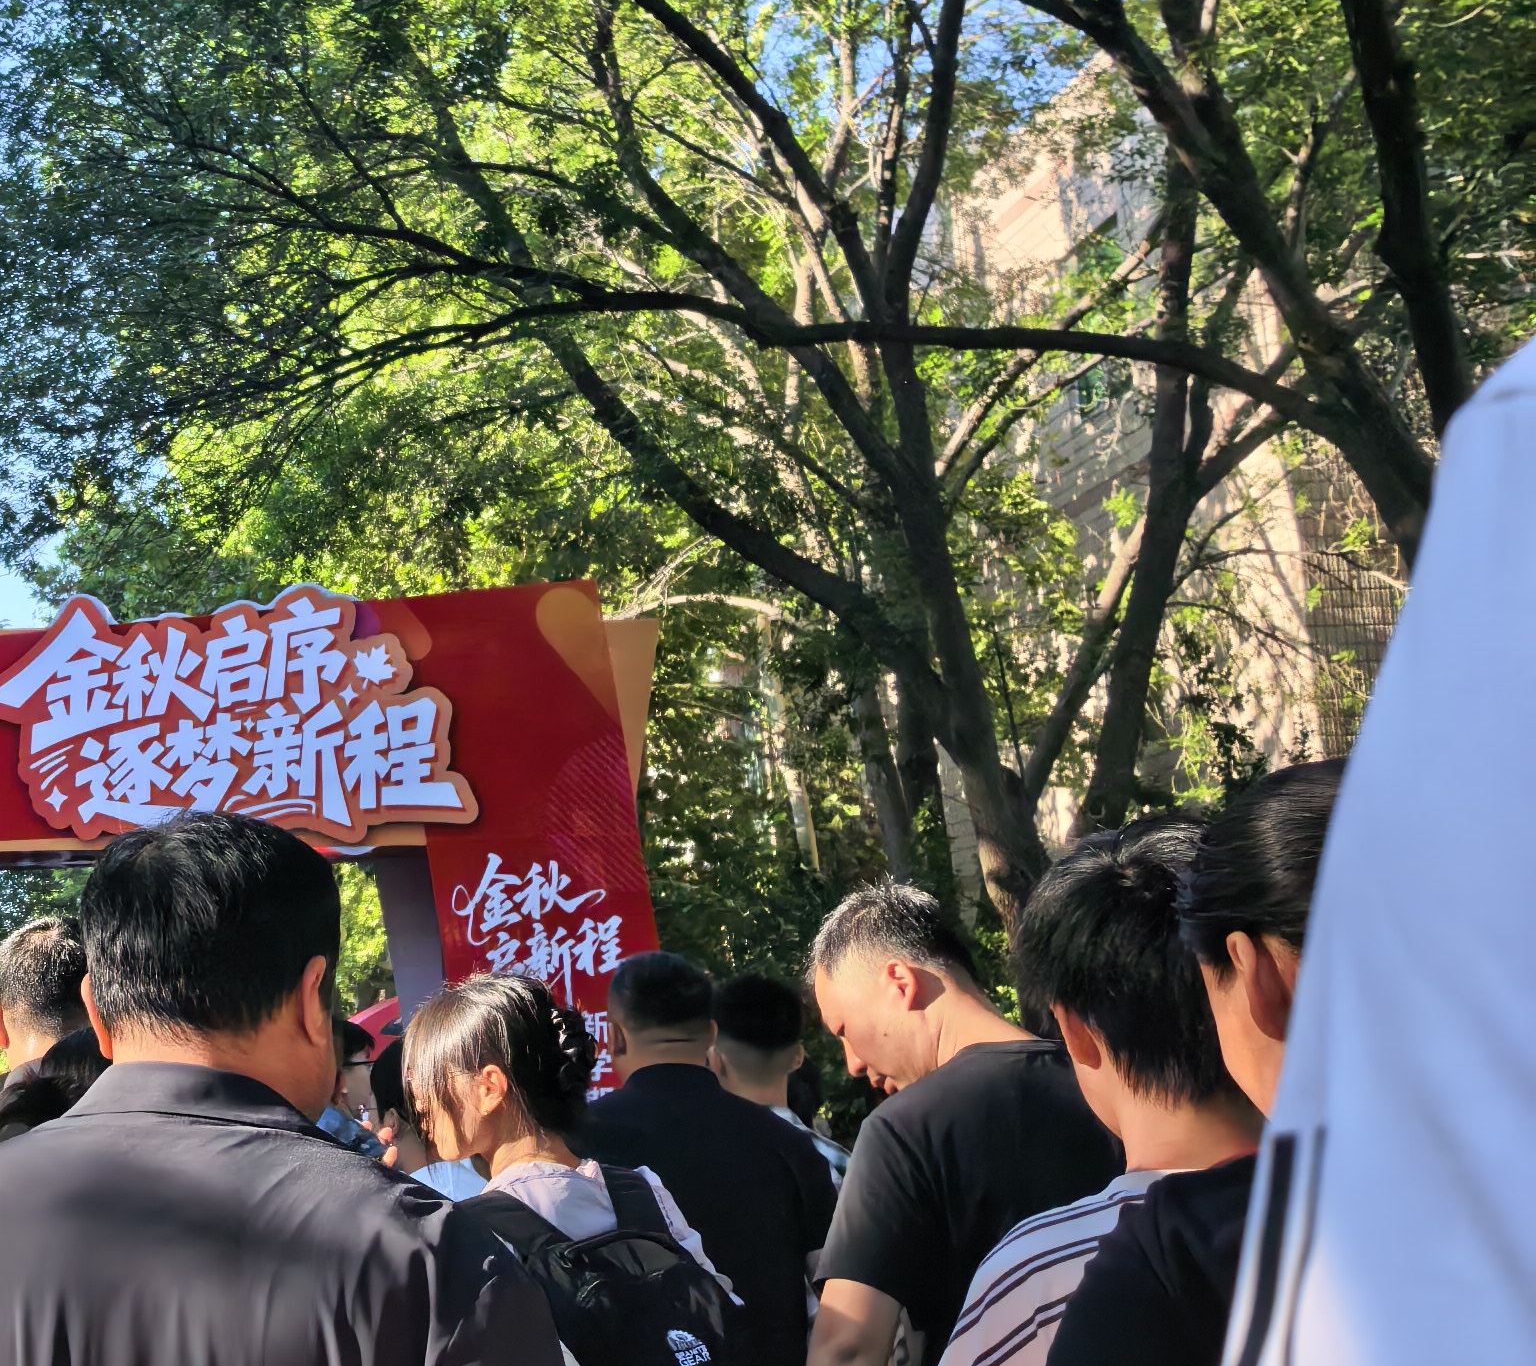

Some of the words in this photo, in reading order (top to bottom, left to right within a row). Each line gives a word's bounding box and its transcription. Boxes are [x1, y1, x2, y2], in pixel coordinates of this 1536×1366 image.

[75, 697, 464, 827] 逐梦新程
[452, 852, 606, 945] 金秋
